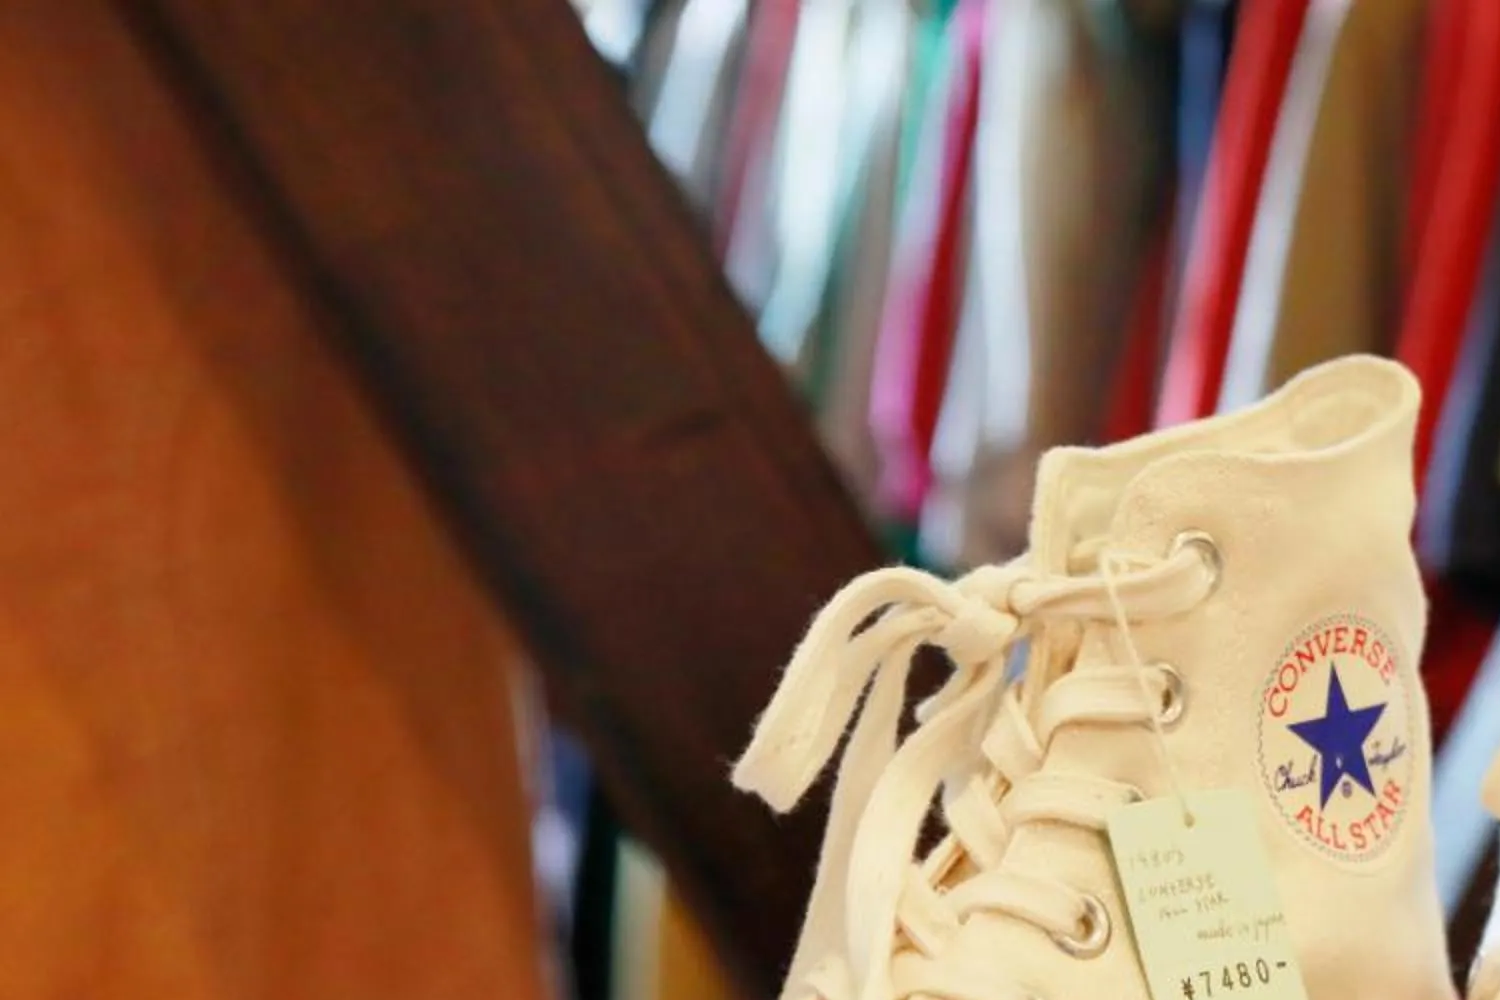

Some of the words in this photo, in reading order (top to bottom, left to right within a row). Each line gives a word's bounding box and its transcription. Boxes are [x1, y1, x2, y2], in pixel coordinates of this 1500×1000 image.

[1266, 626, 1398, 718] CONVERSE
[1274, 754, 1318, 793] Chuck
[1296, 803, 1347, 850] ALL
[1348, 780, 1404, 850] STAR
